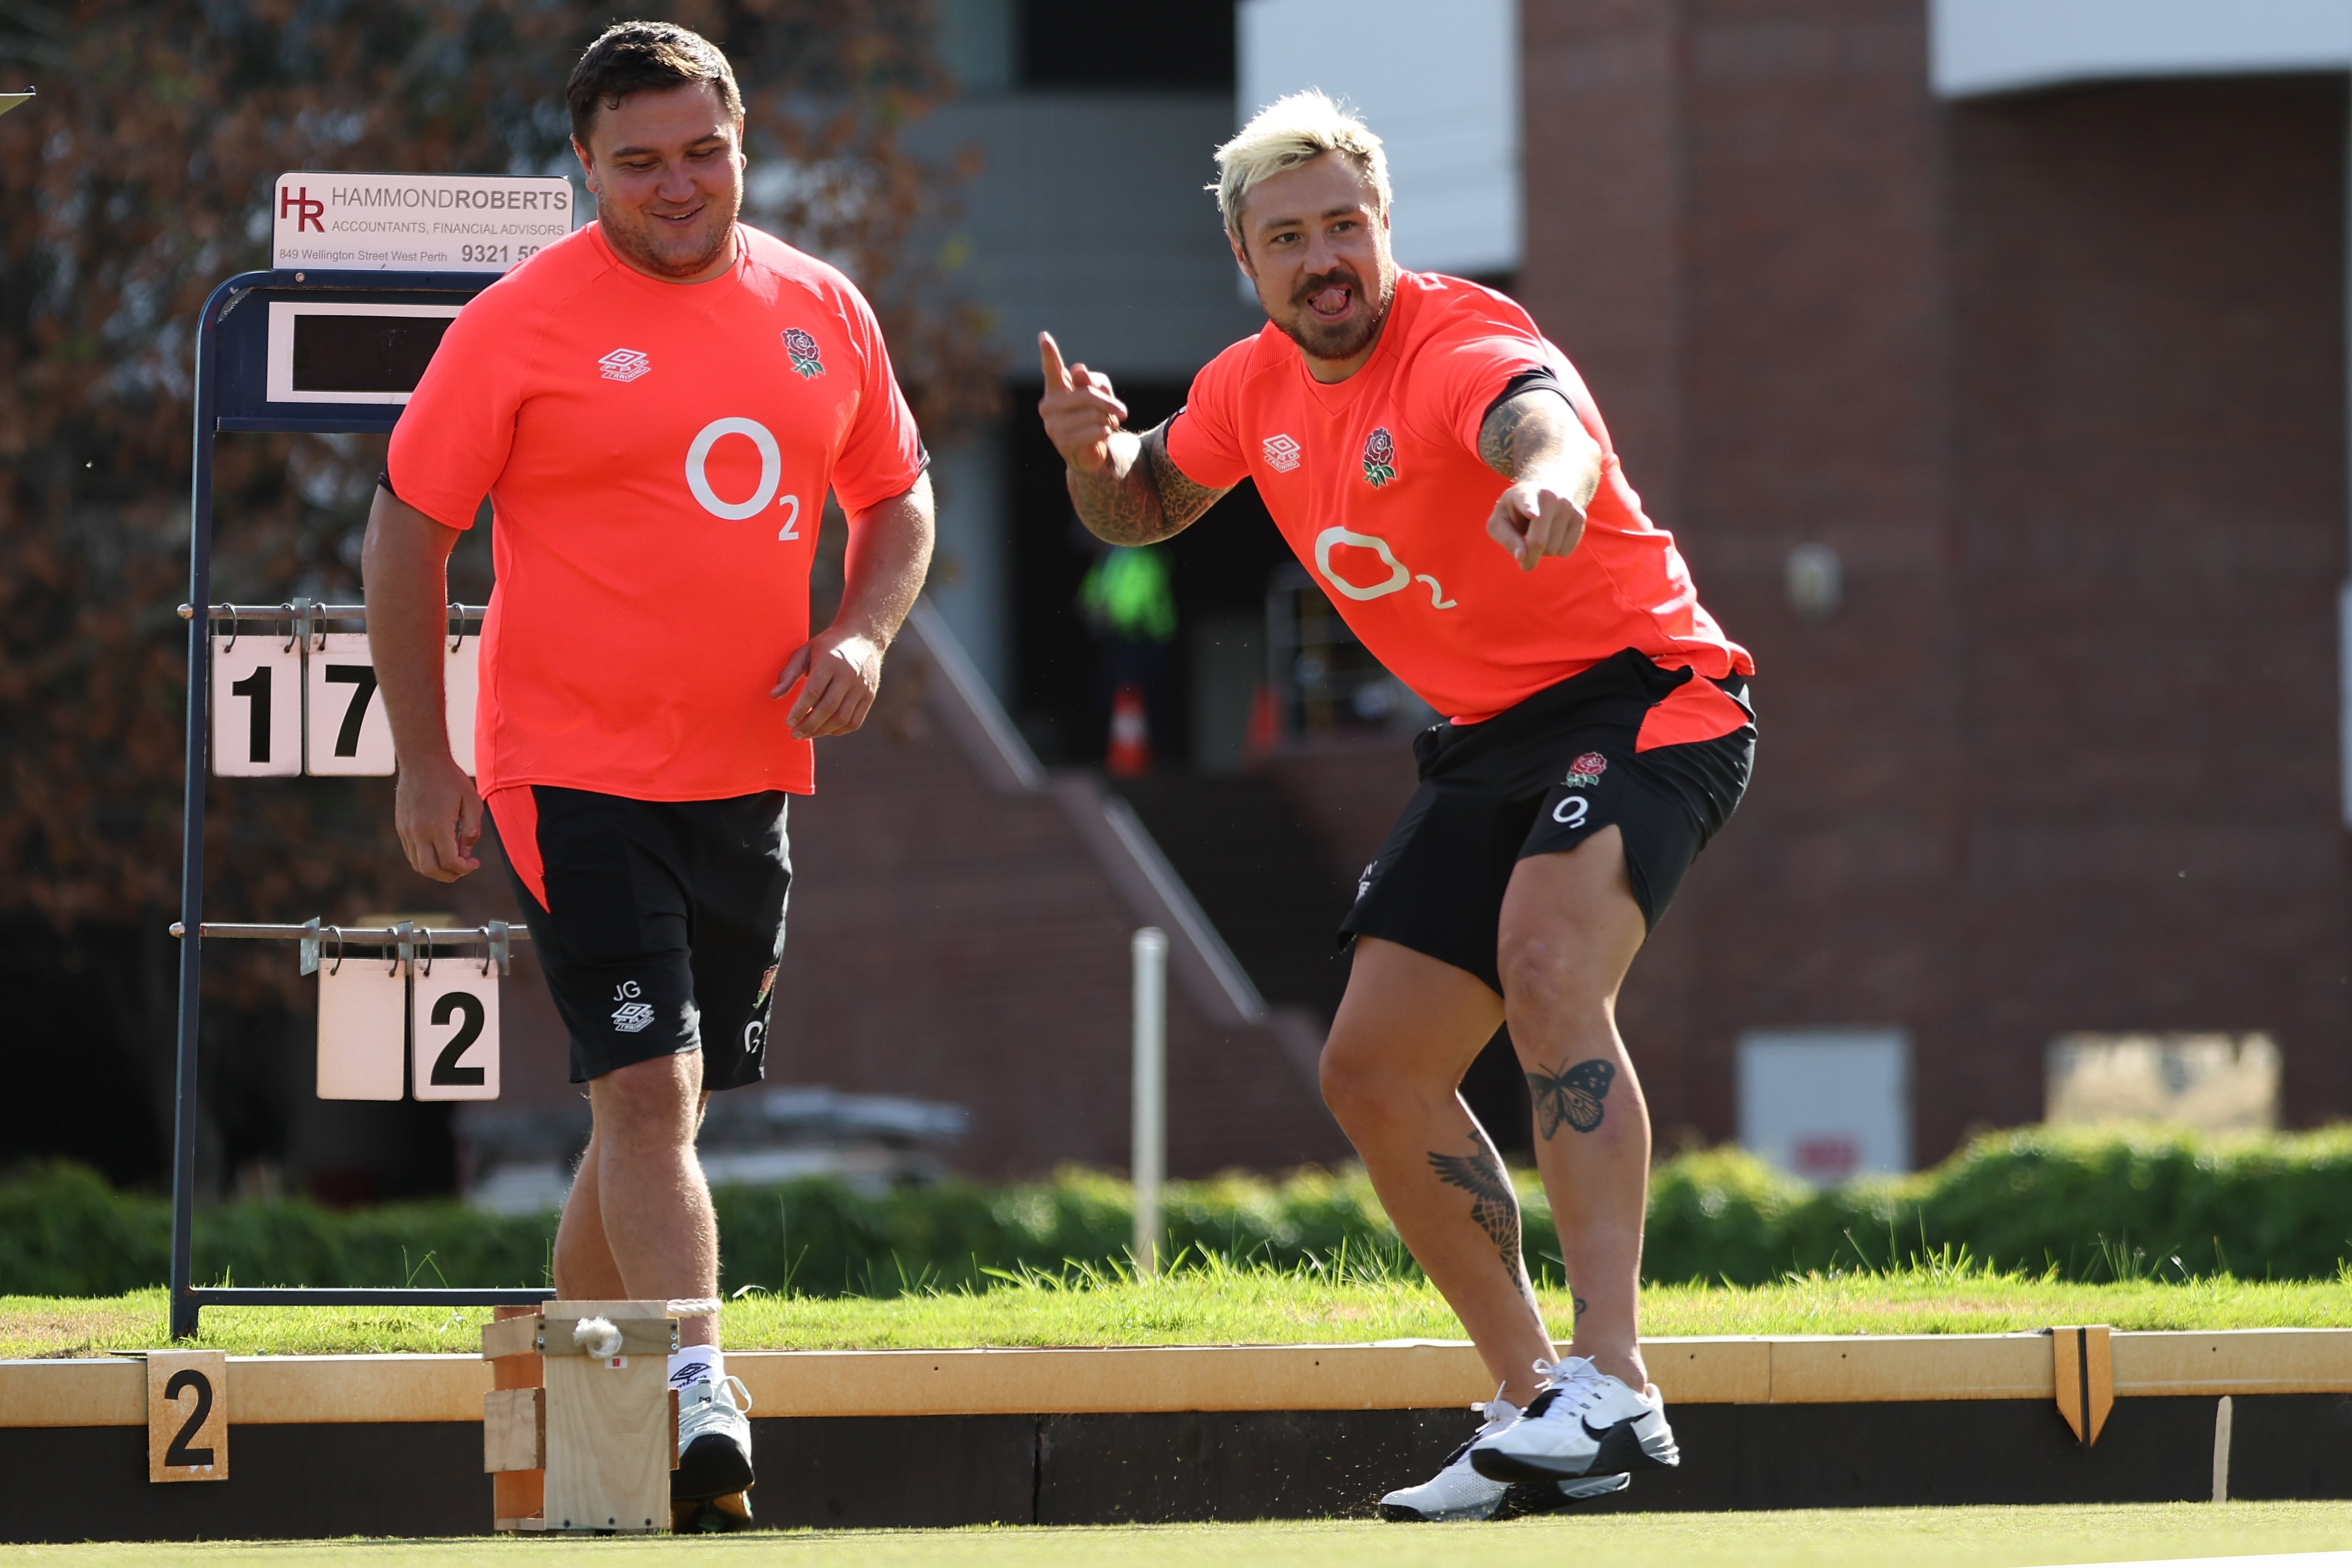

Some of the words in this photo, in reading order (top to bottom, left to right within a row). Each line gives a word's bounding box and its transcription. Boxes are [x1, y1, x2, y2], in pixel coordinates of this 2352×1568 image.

[332, 187, 567, 210] HAMMONDROBERTS
[332, 221, 428, 234] ACCOUNTANTS,
[433, 223, 498, 235] FINANCIAL
[500, 225, 564, 236] ADVISORS
[279, 250, 298, 259] 849
[301, 250, 355, 262] Wellington
[358, 251, 388, 261] Street
[391, 251, 417, 261] West
[420, 252, 447, 261] Perth
[461, 244, 508, 262] 9321
[608, 368, 647, 380] TRAINING
[685, 416, 799, 541] O2
[613, 980, 641, 1001] JG
[430, 991, 485, 1086] 2
[164, 1369, 214, 1466] 2
